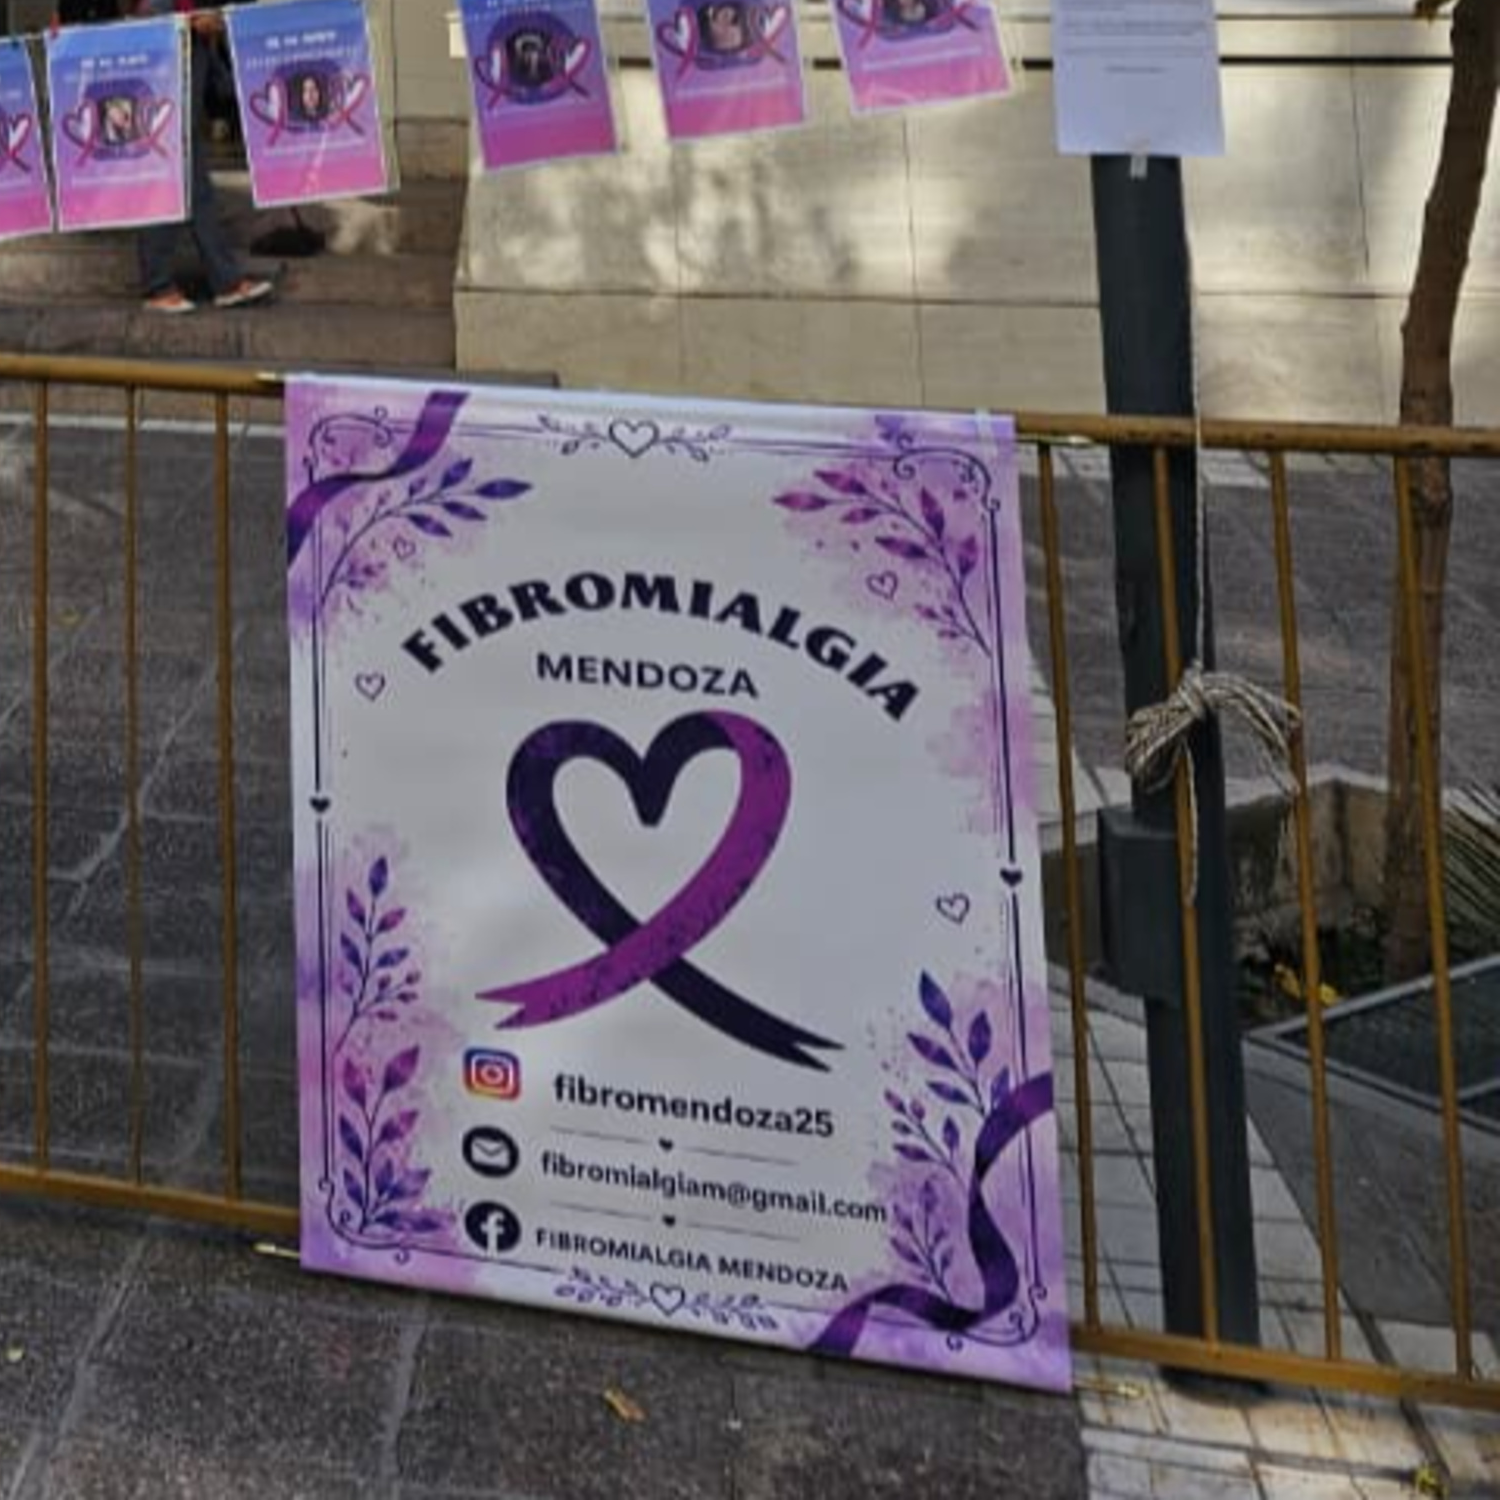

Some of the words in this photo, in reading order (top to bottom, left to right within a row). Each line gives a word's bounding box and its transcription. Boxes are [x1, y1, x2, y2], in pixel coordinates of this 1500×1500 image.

[401, 571, 920, 721] FIBROMIALGIA
[536, 652, 759, 699] MENDOZA
[554, 1073, 834, 1138] fibromendoza25
[541, 1150, 888, 1224] fibromialgiam@gmail.com
[536, 1228, 712, 1273] FIBROMIALGIA
[717, 1256, 849, 1293] MENDOZA
